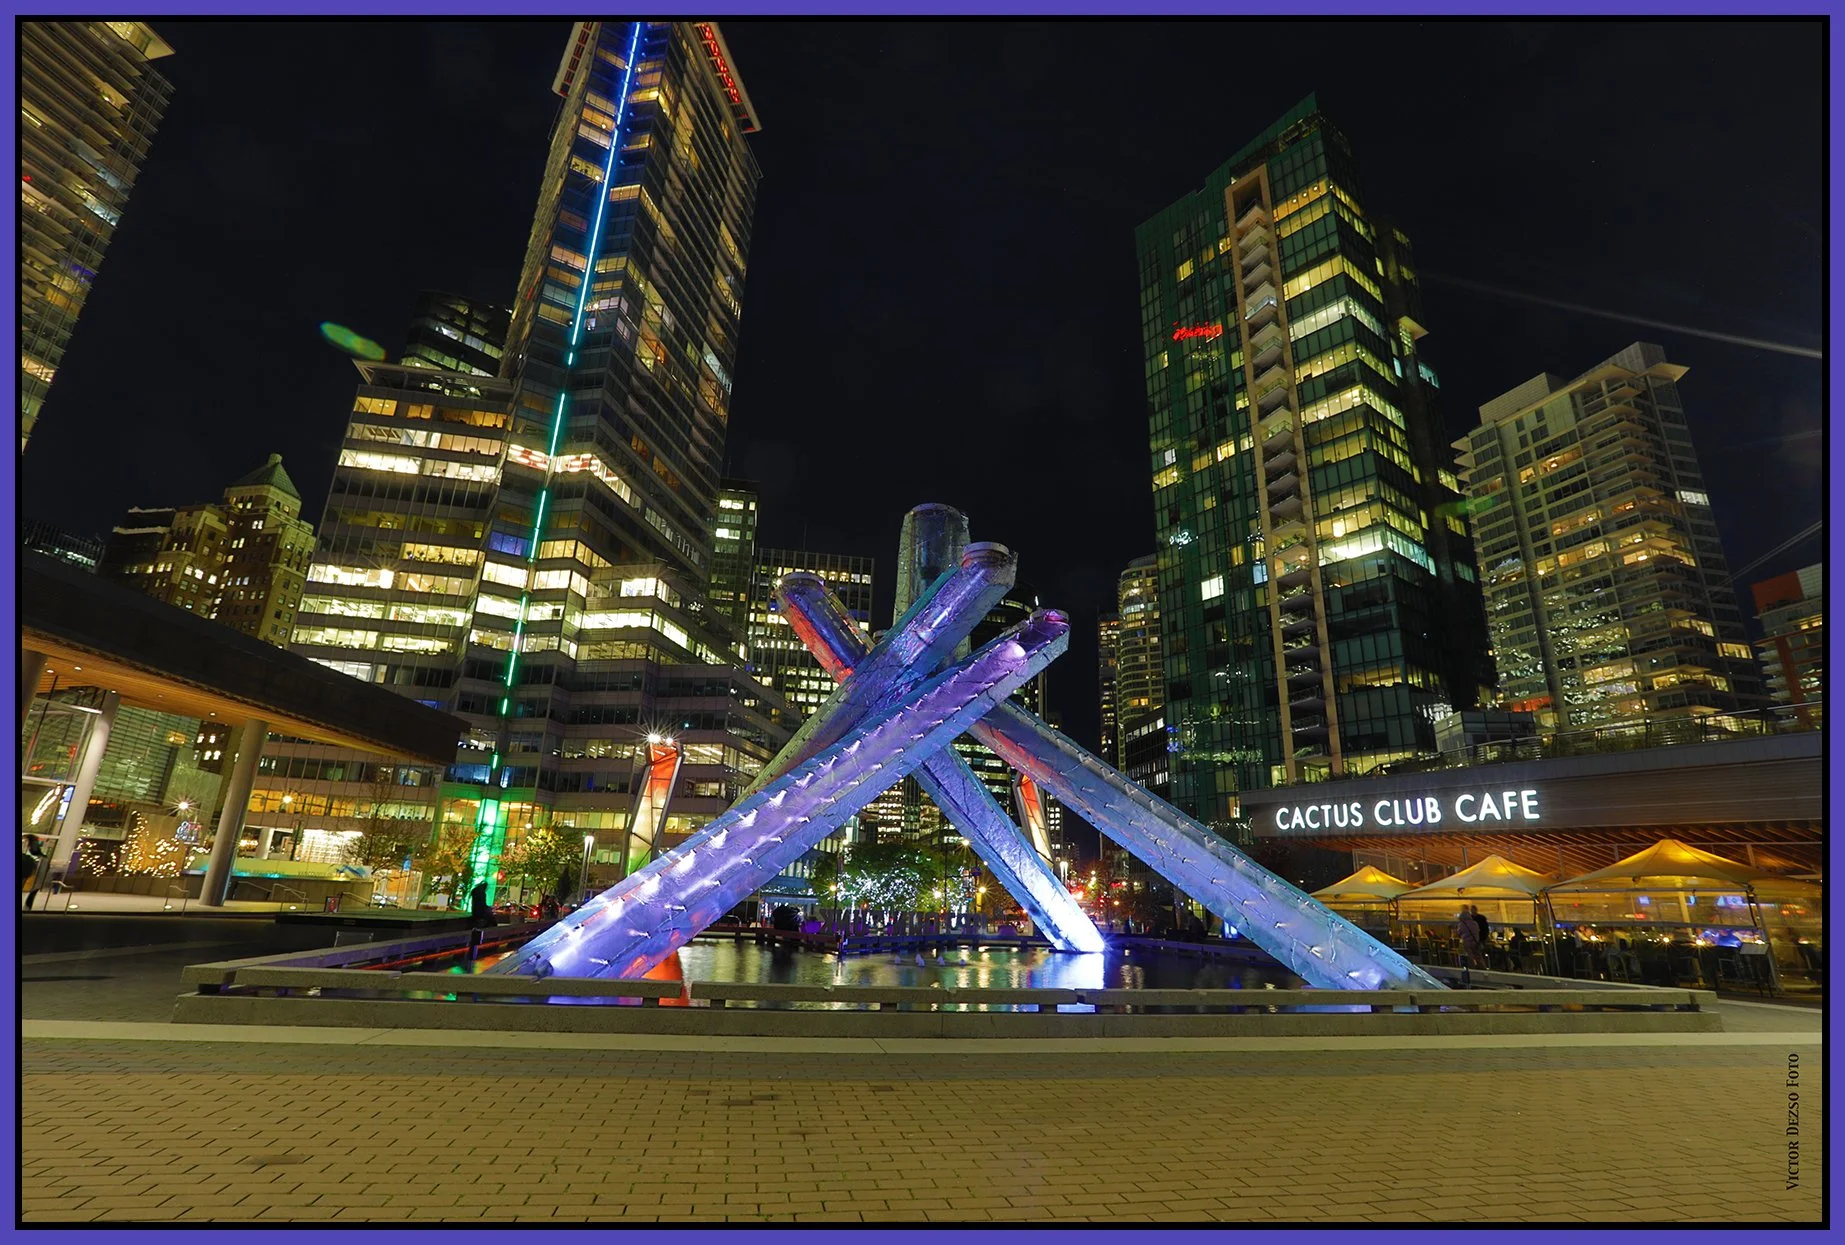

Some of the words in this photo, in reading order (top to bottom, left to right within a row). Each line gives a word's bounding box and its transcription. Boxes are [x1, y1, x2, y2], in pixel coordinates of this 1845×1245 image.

[1275, 802, 1363, 830] CACTUS
[1374, 797, 1442, 826] CLUB
[1455, 789, 1540, 822] CAFE
